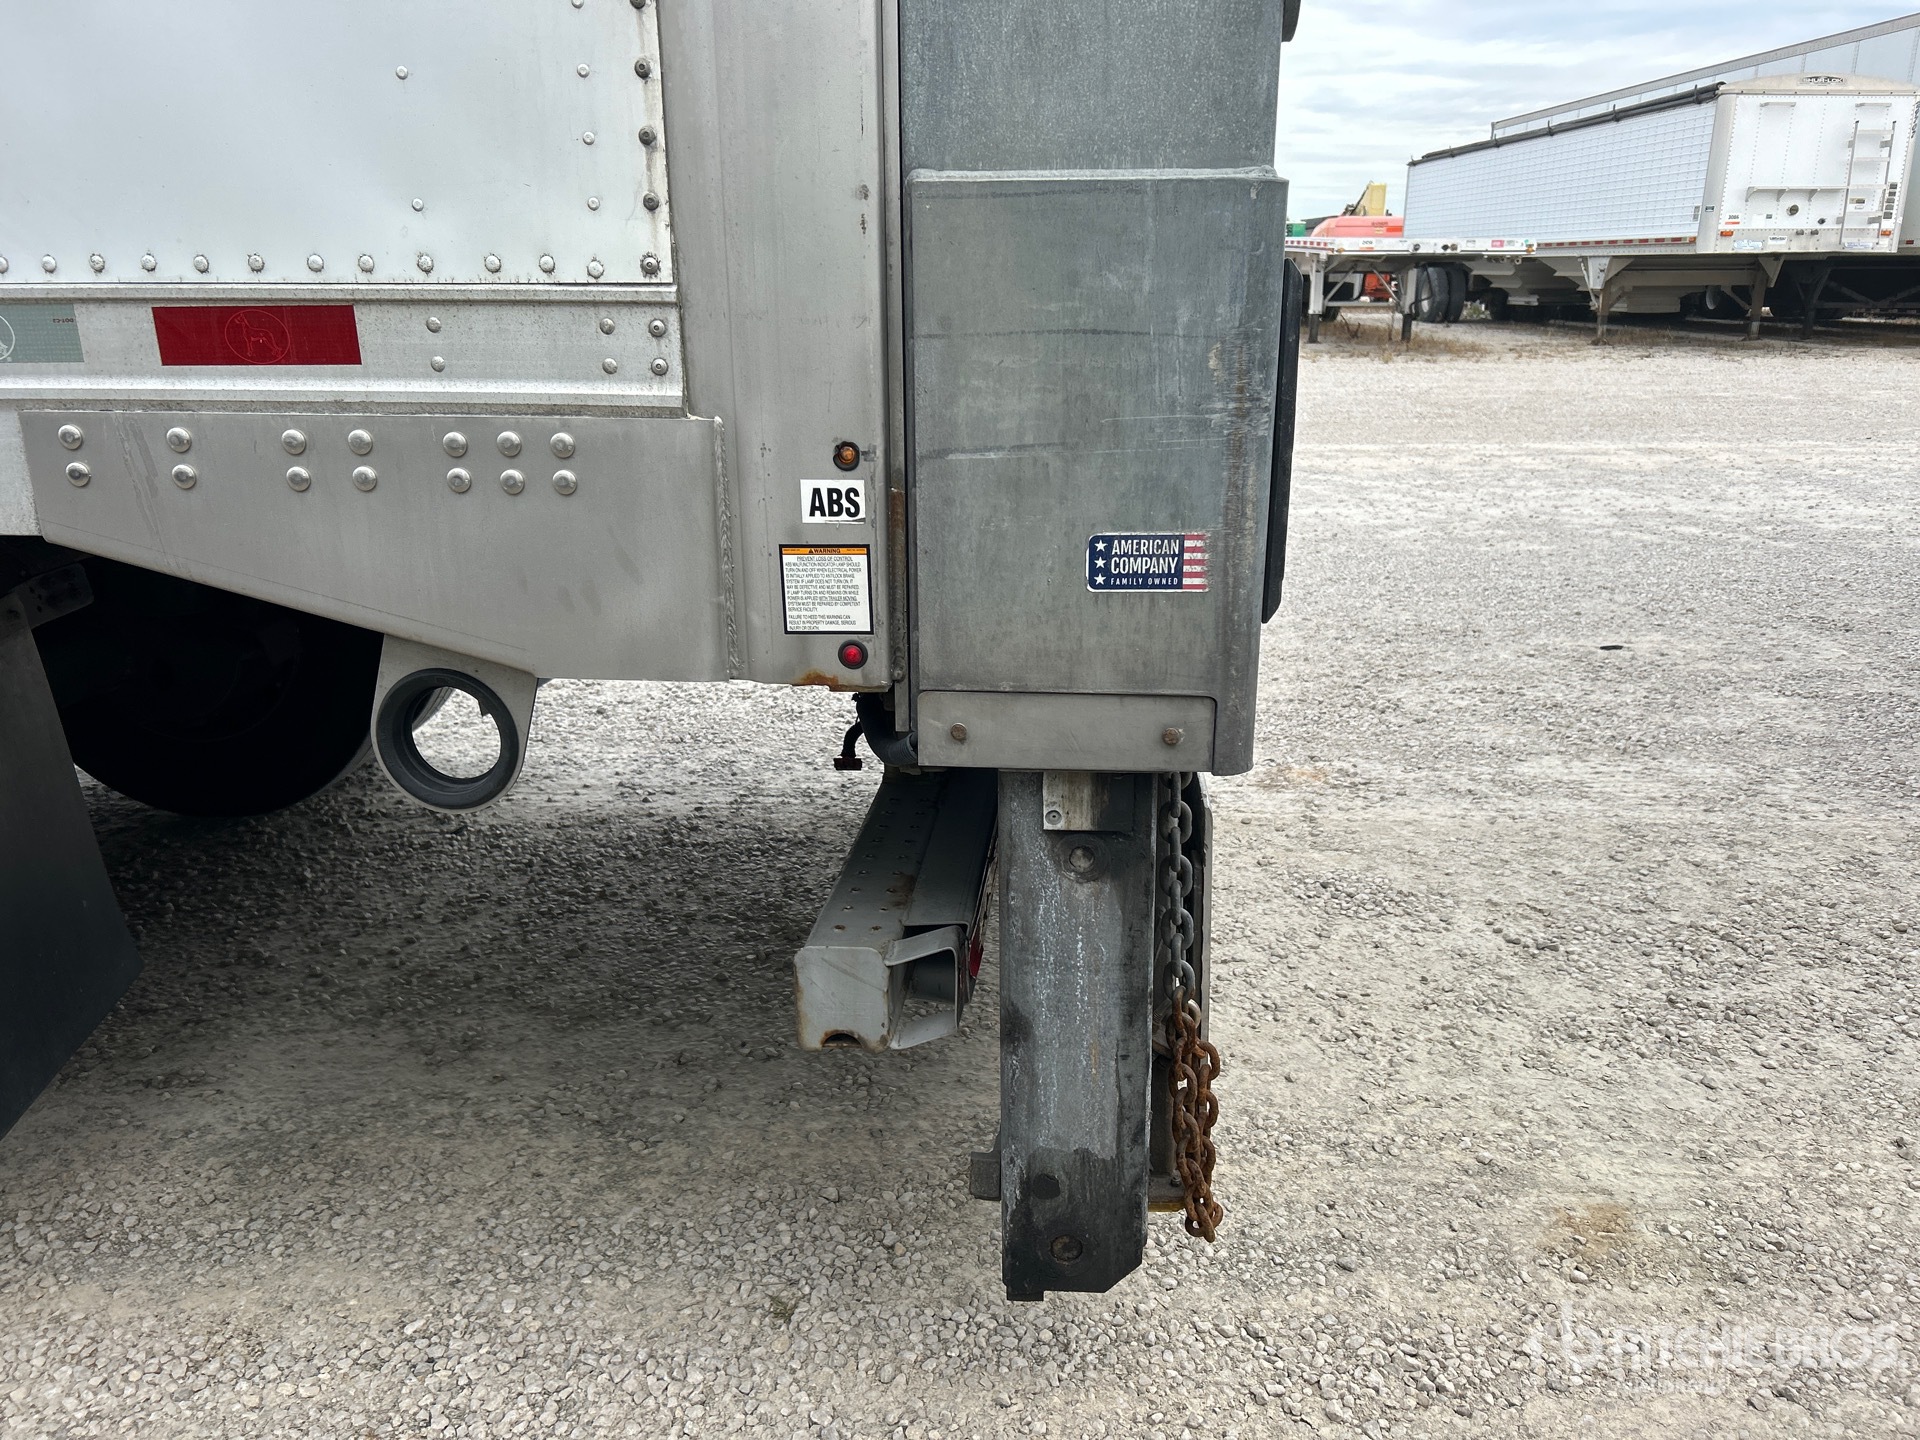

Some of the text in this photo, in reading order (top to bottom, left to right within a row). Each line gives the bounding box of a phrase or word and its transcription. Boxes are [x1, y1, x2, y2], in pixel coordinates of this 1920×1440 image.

[808, 486, 861, 518] ABS
[1111, 539, 1179, 555] AMERICAN
[1110, 556, 1178, 574] COMPANY
